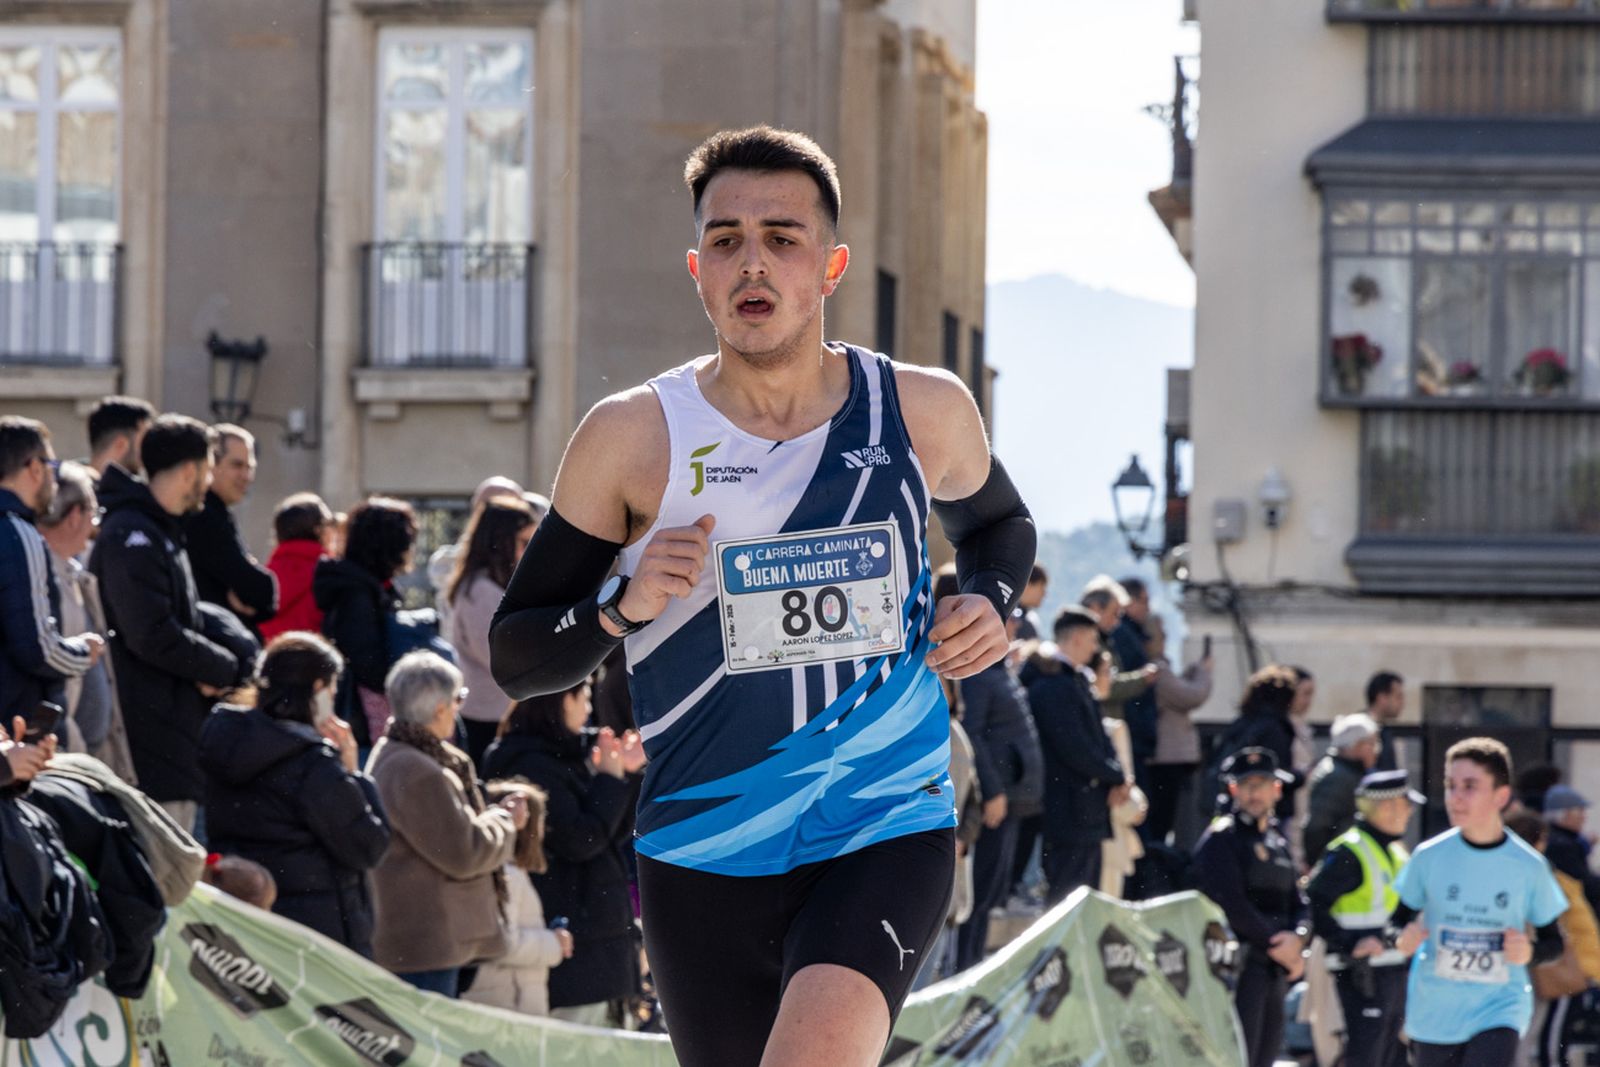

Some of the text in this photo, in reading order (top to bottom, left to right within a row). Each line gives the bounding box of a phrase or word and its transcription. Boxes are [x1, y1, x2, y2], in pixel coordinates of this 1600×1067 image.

[862, 445, 886, 457] RUN
[706, 466, 758, 474] DIPUTACIÓN
[720, 475, 741, 483] JAÉN
[755, 544, 812, 561] CARRERA
[814, 536, 872, 554] CAMINATA
[742, 558, 850, 588] BUENA MUERTE
[781, 585, 849, 637] 80
[782, 637, 810, 647] AARON
[811, 634, 832, 643] LOPEZ
[1451, 949, 1494, 972] 270
